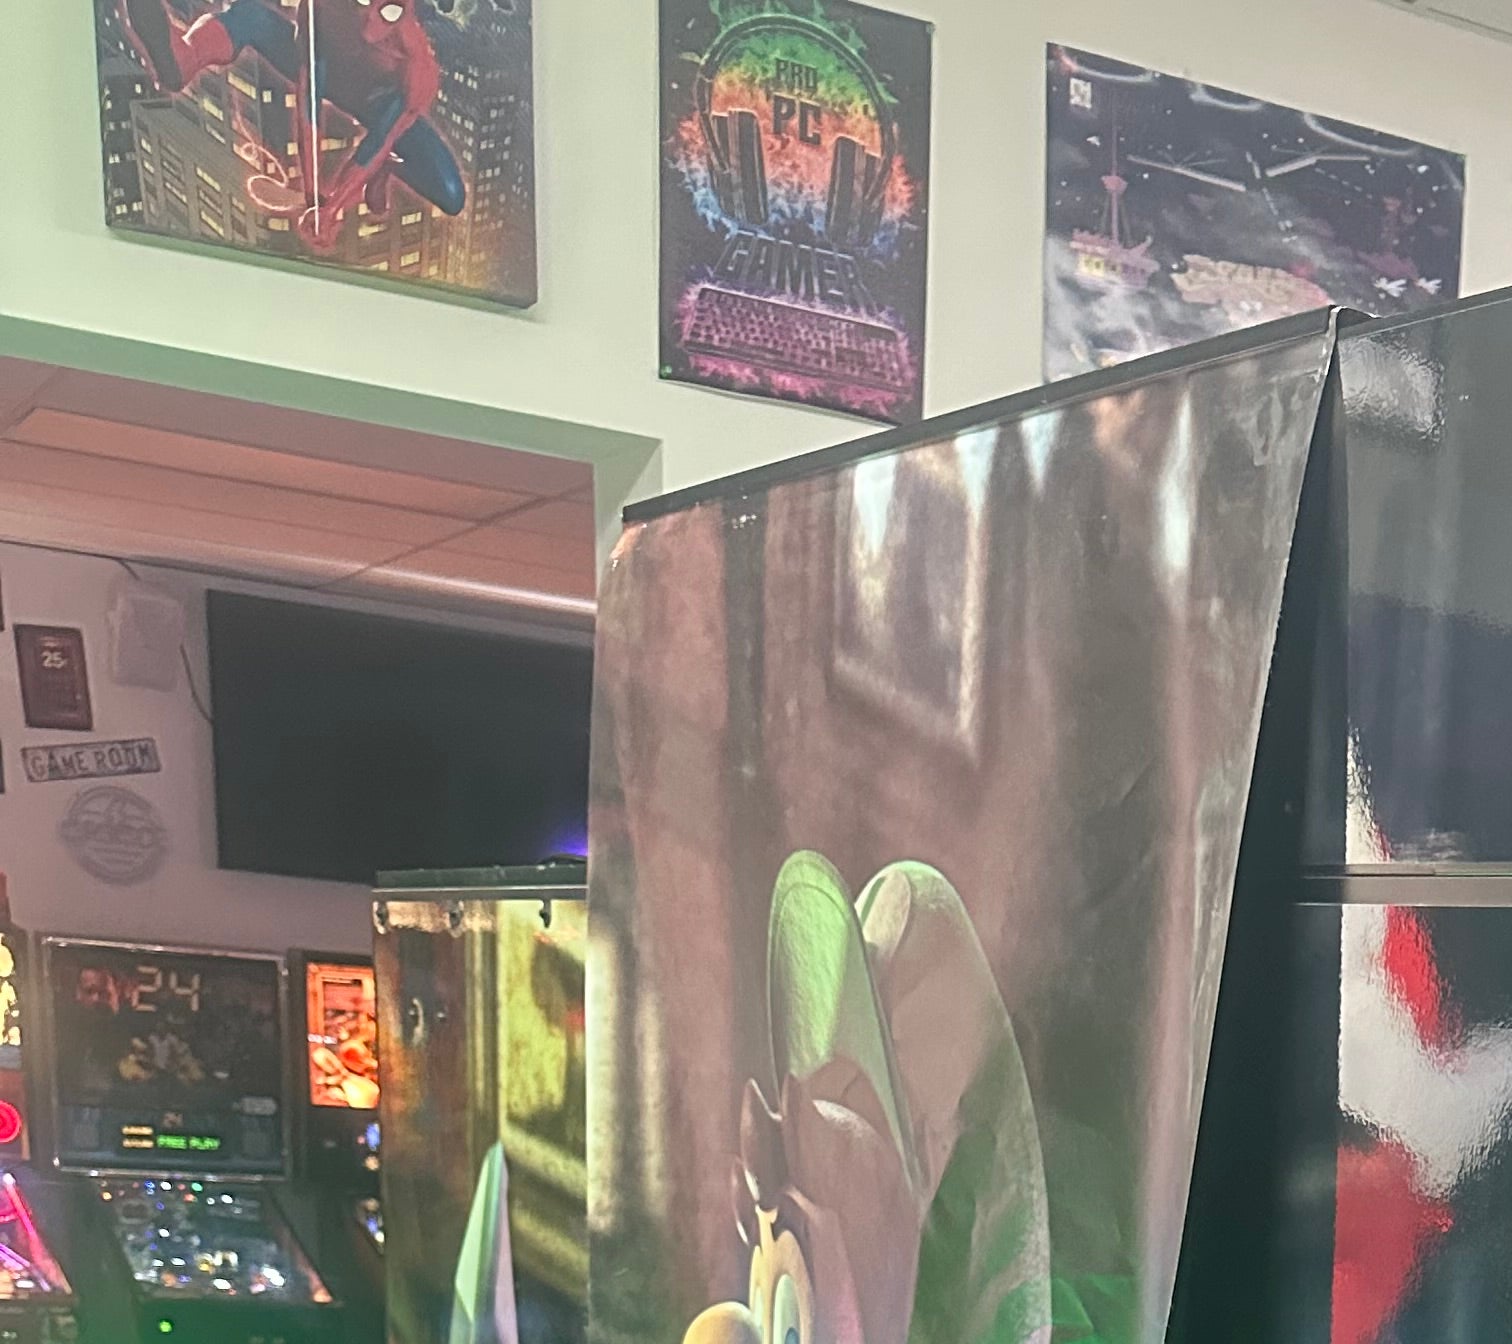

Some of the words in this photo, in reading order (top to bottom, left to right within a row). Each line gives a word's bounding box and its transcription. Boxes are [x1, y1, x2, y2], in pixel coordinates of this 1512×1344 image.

[775, 57, 818, 90] PRO
[773, 94, 822, 146] PC
[715, 229, 872, 306] GAMER
[31, 748, 91, 780] GAME
[93, 741, 152, 771] ROOM
[131, 965, 200, 1013] 24
